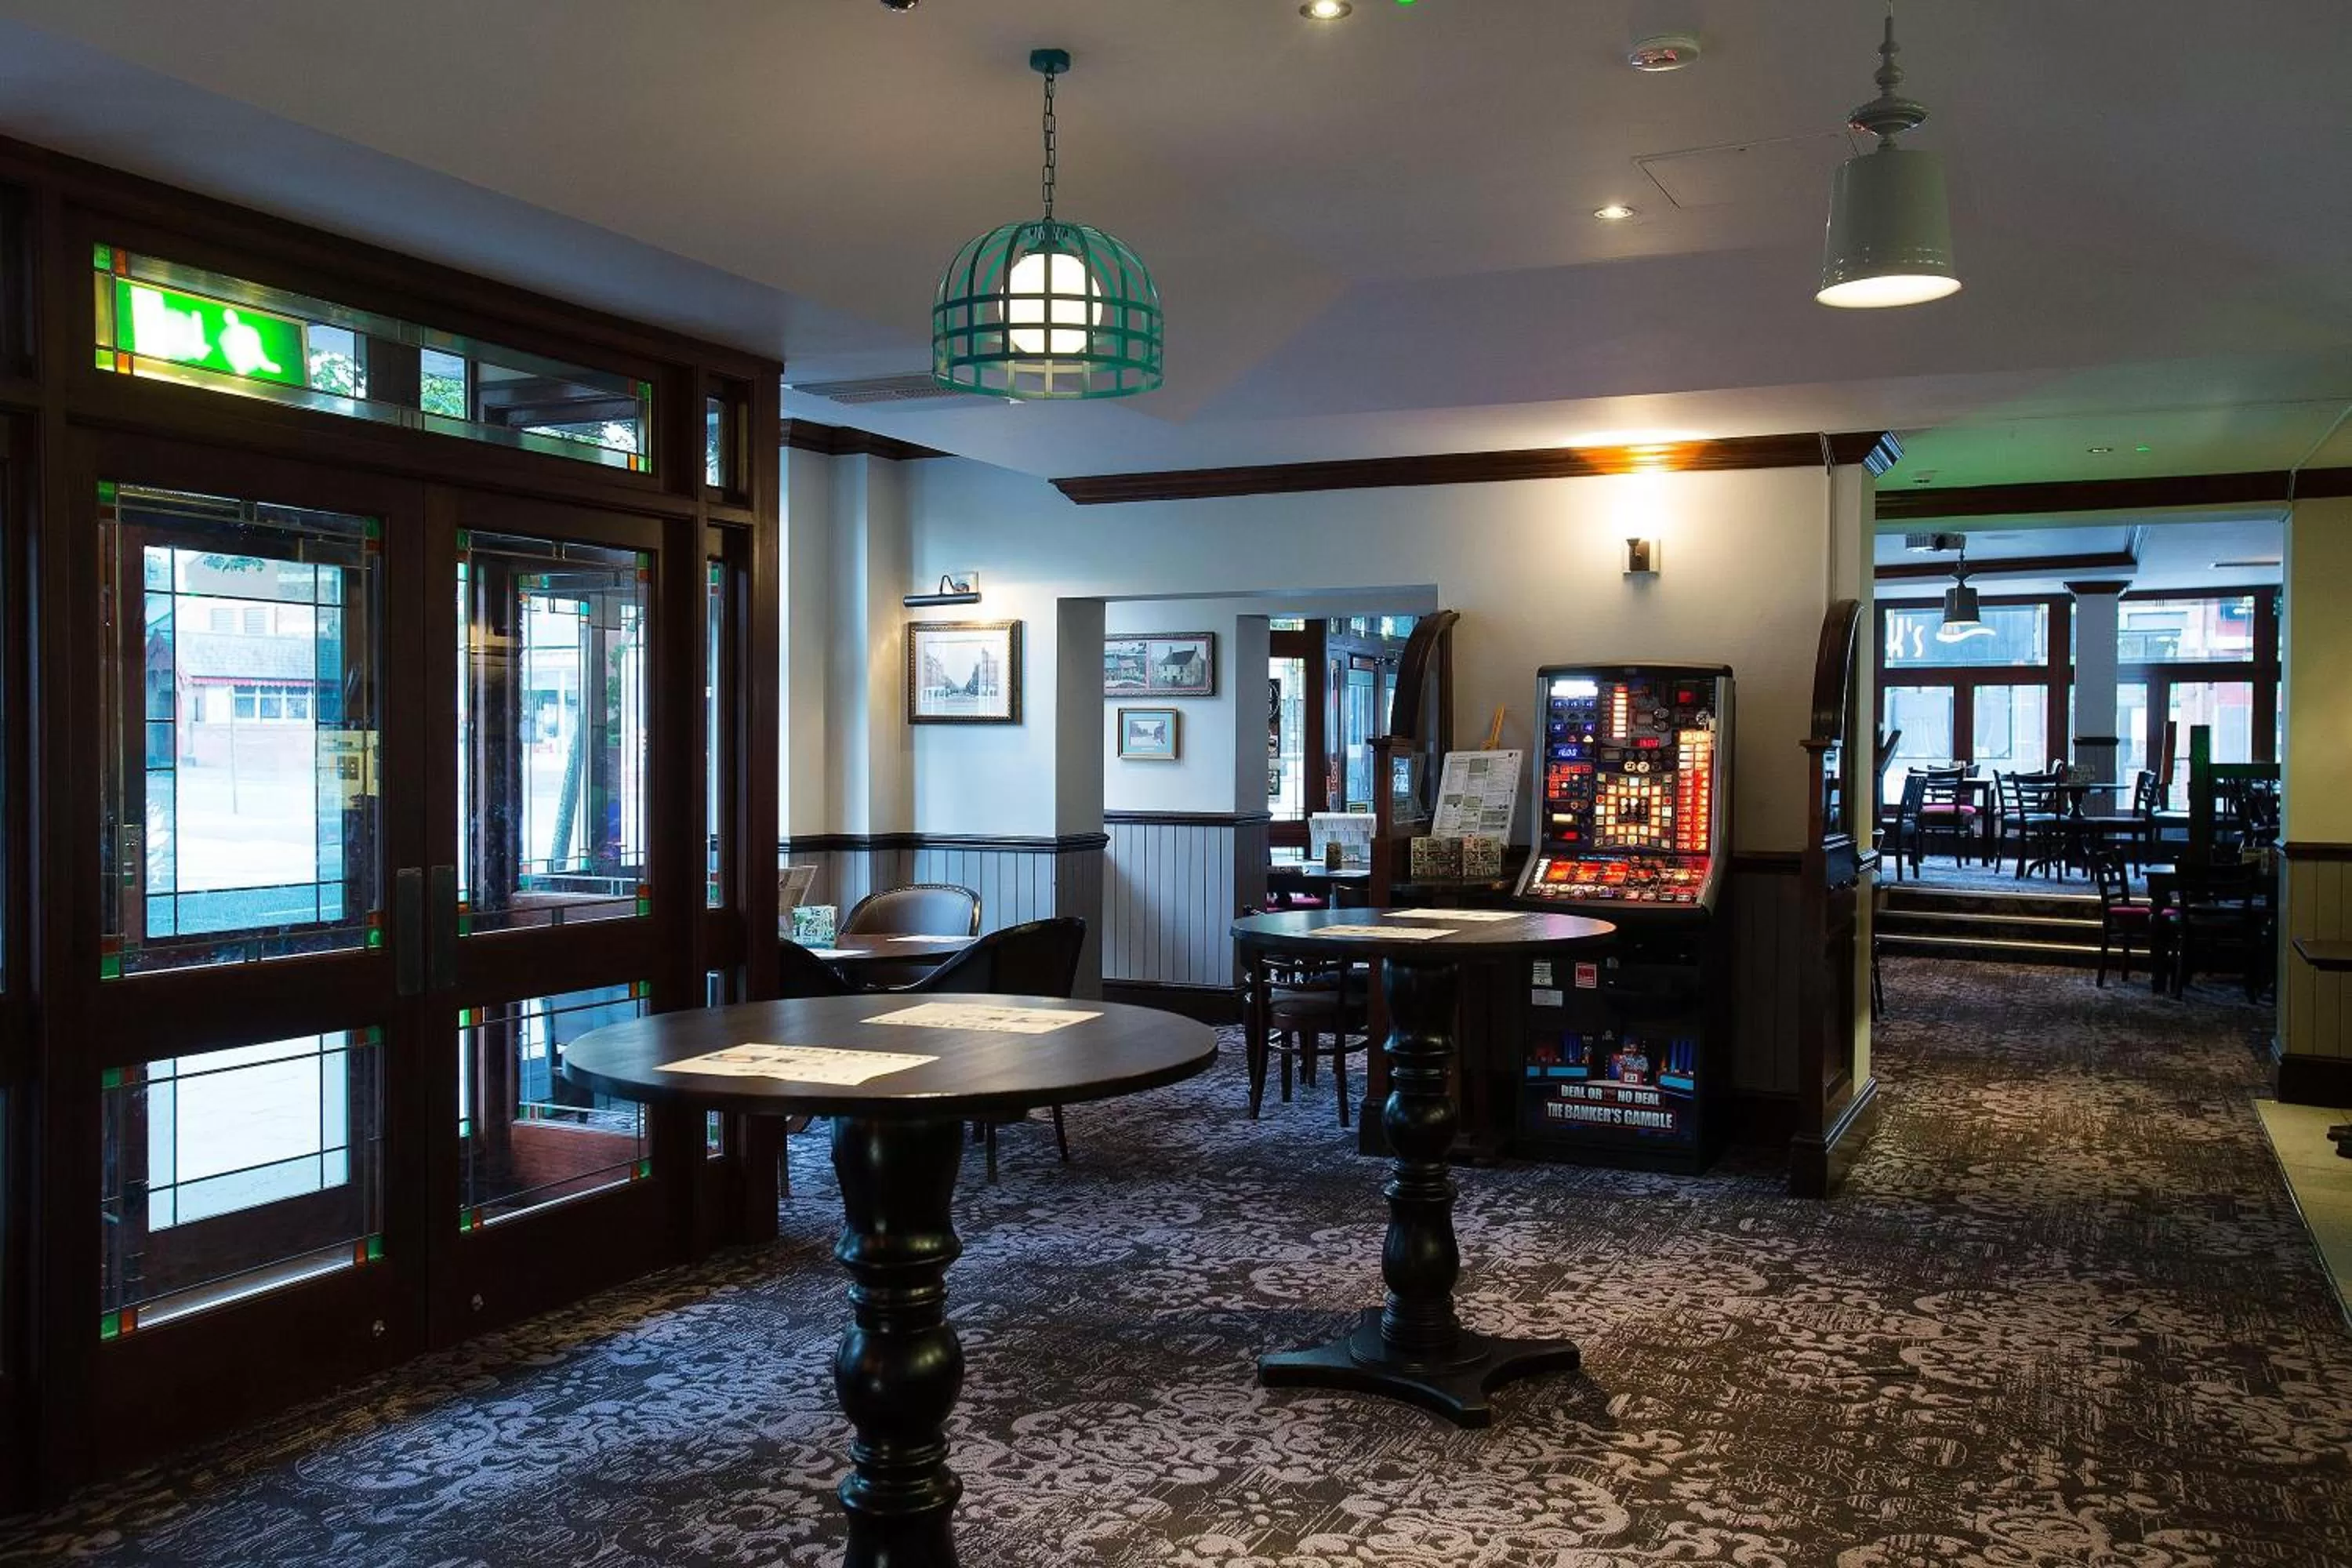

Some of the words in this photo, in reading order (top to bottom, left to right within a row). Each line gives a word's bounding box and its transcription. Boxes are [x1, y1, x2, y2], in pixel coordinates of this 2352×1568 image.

[1561, 1084, 1585, 1098] DEAL
[1588, 1087, 1602, 1101] OR
[1617, 1089, 1633, 1103] NO
[1634, 1091, 1661, 1106] DEAL
[1547, 1101, 1563, 1118] THE
[1563, 1103, 1622, 1124] BANKER'S
[1624, 1109, 1673, 1130] GAMBLE
